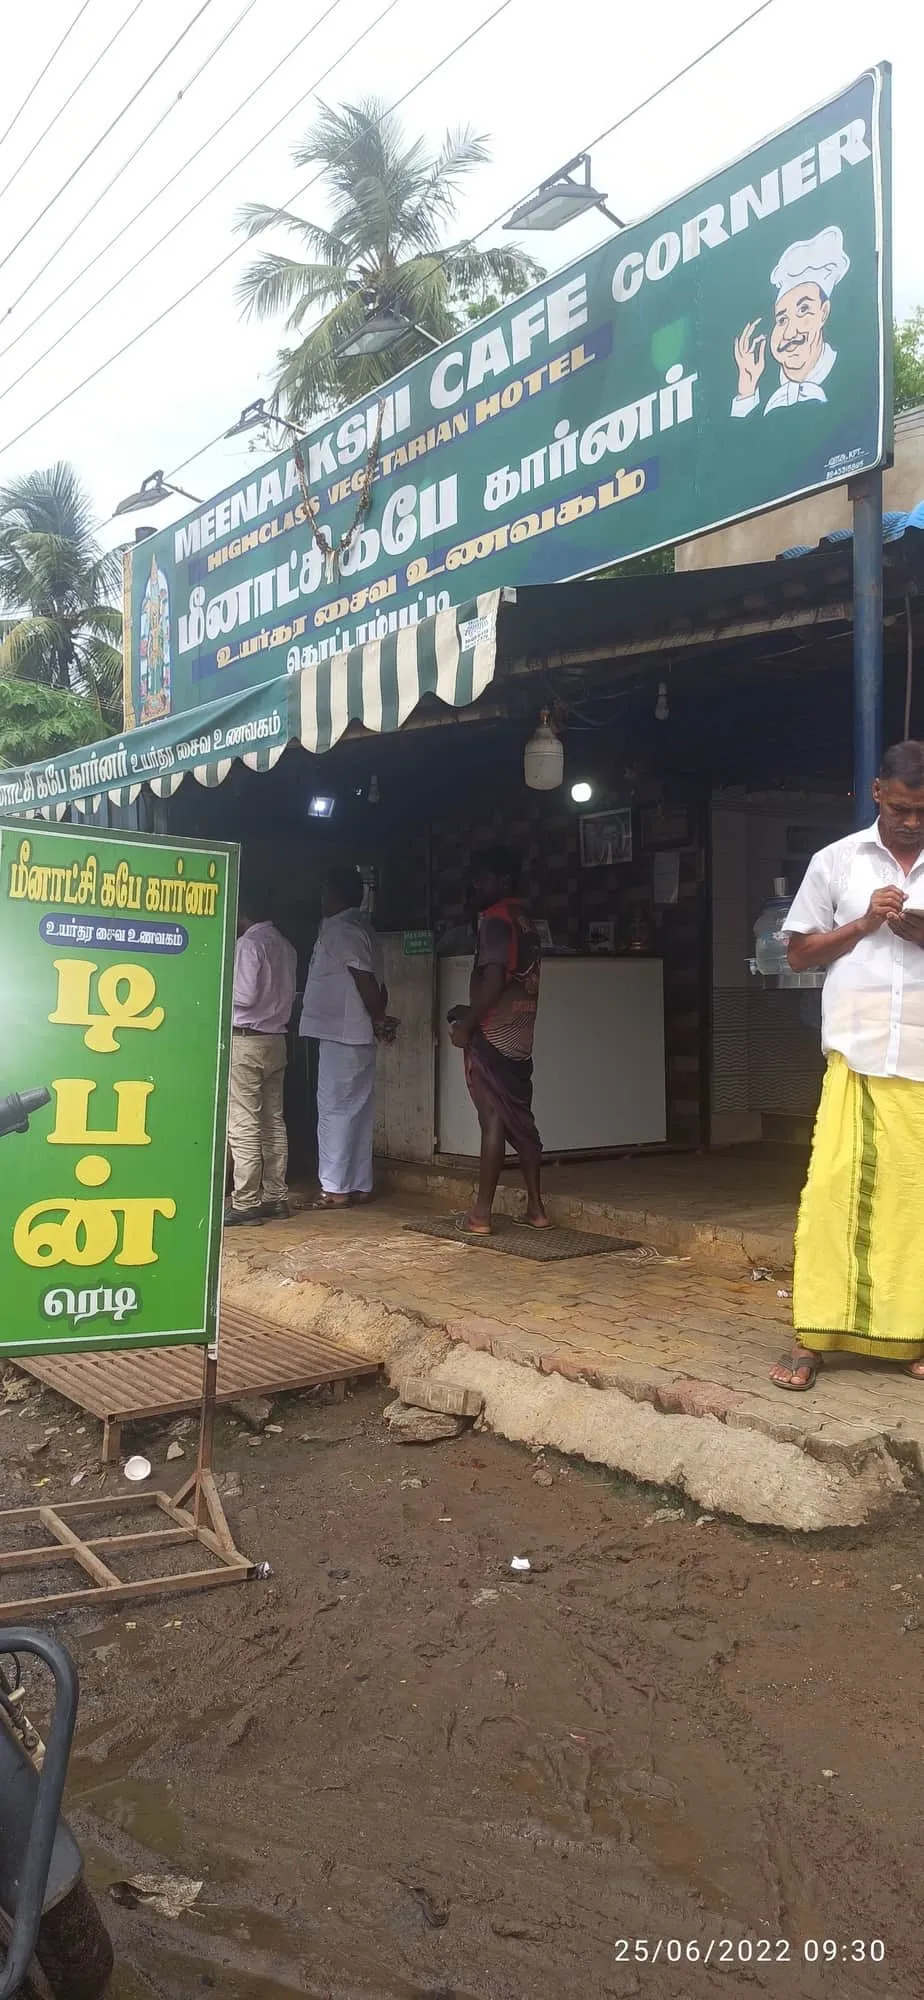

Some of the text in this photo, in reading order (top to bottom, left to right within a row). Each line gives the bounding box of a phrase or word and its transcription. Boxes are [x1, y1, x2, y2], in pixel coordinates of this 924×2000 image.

[174, 118, 872, 564] MEENAAKSHI CAFE CORNER
[476, 343, 595, 425] HOTEL
[338, 473, 458, 577] கபே
[483, 363, 698, 511] கார்னர்
[216, 466, 646, 669] உயர்தர சைவ உணவகம்
[36, 763, 67, 798] கபே
[69, 742, 128, 792] கார்னர்
[131, 746, 174, 776] உயர்தர
[177, 739, 211, 760] சைவ
[213, 709, 281, 752] உணவகம்
[9, 840, 218, 916] மீனாட்சி கபே கார்னர்
[46, 918, 183, 946] உயர்தர சைவ உணவகம்
[13, 959, 176, 1268] டிபன்
[44, 1285, 138, 1326] ரெடி
